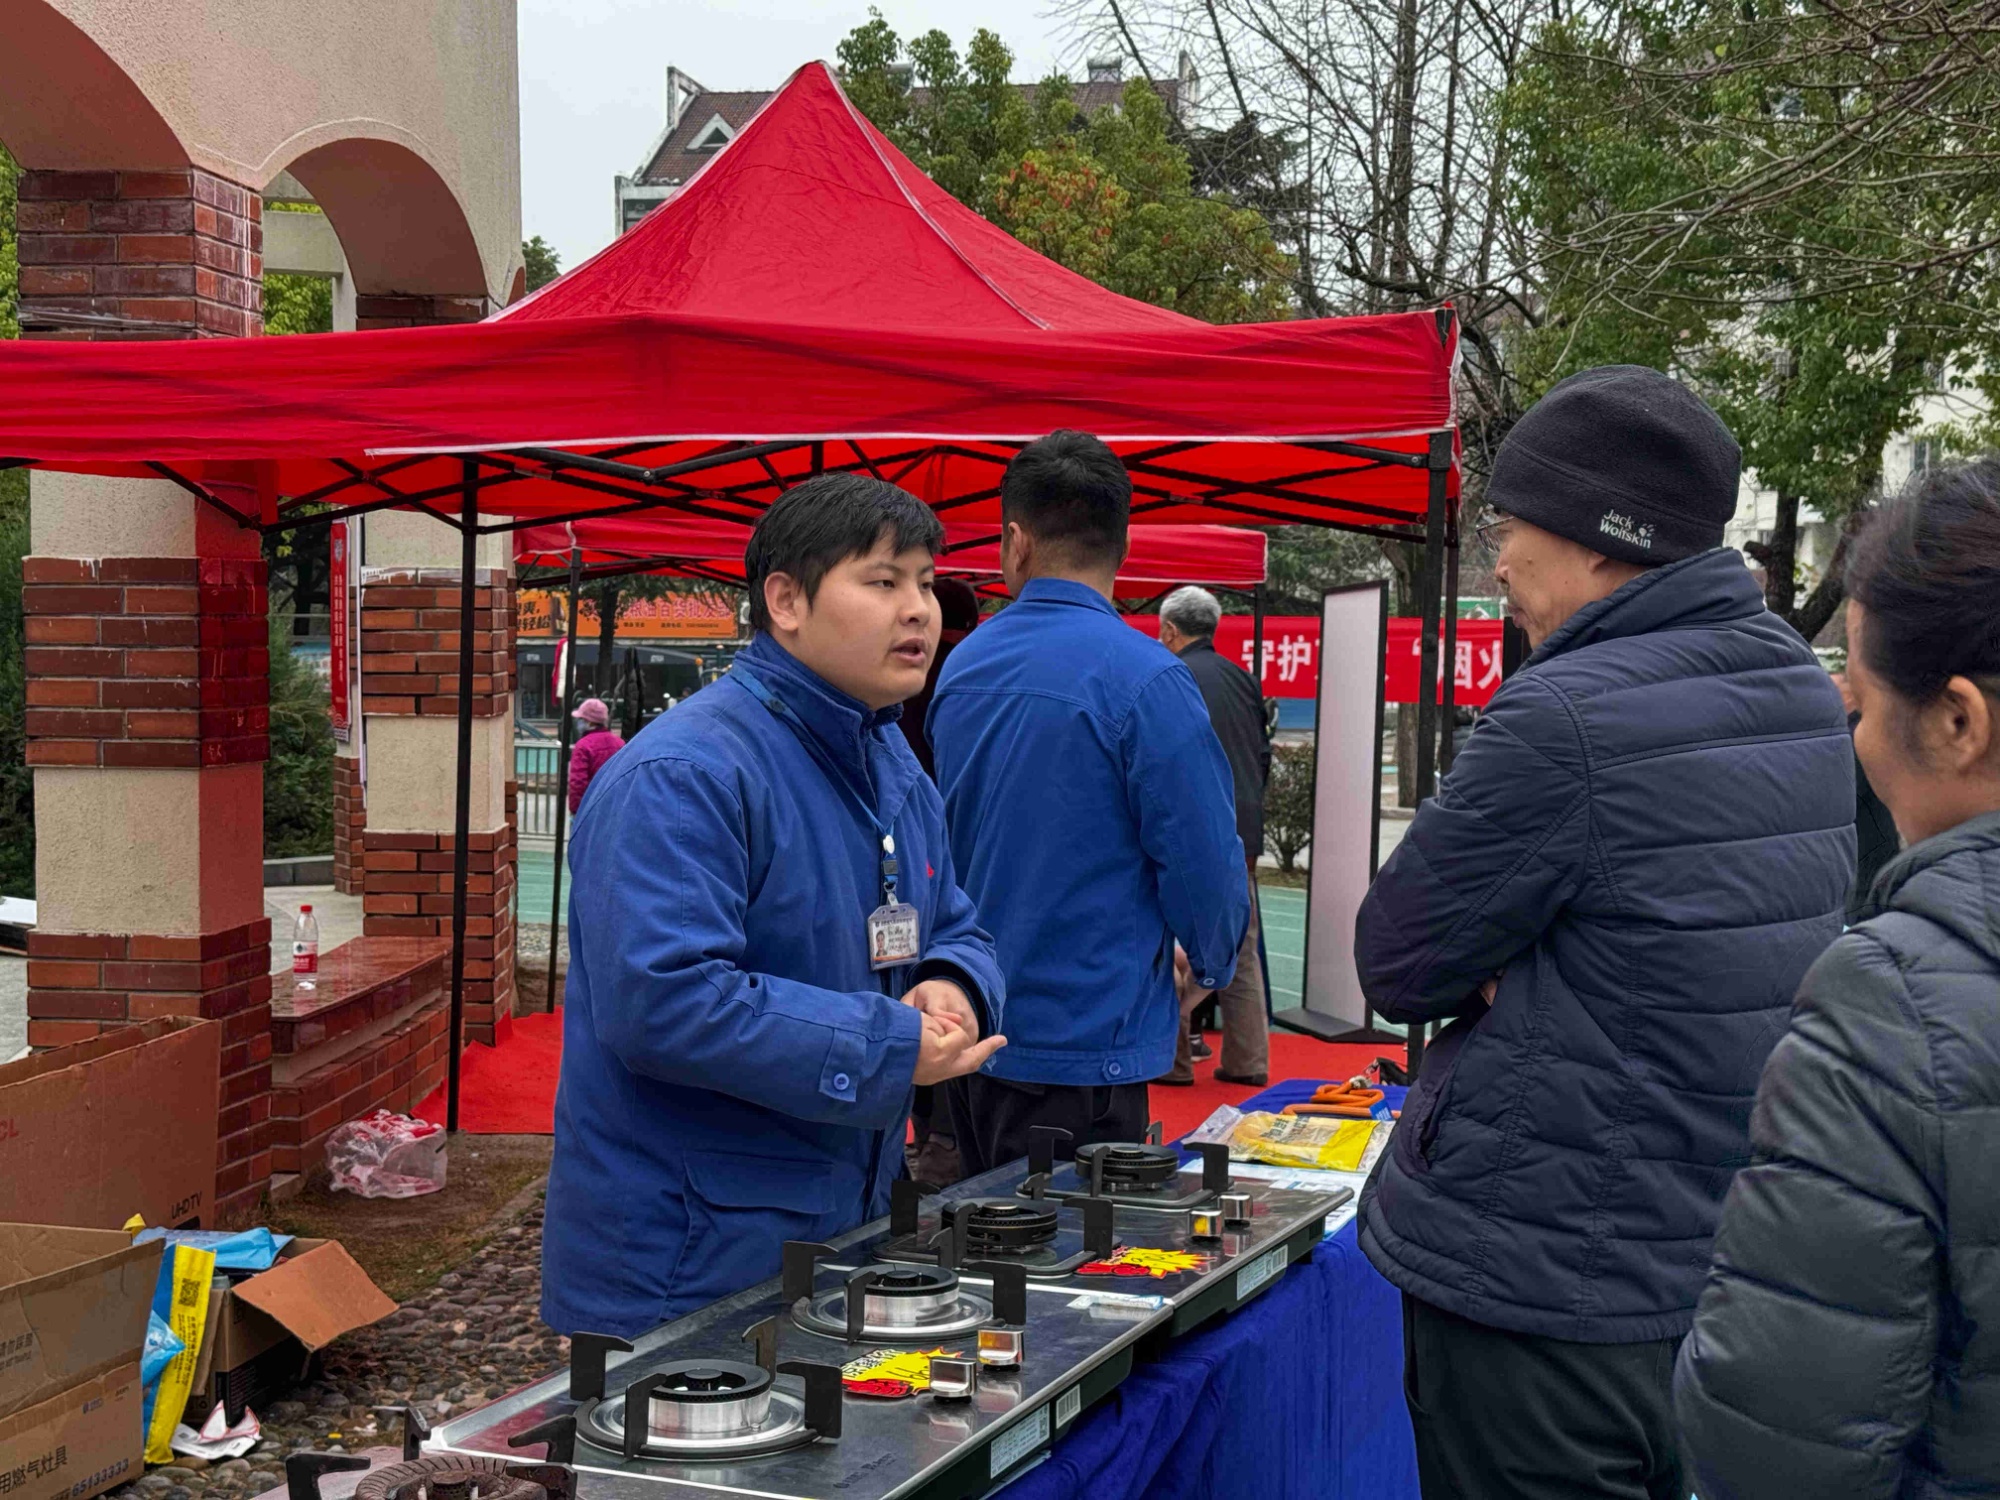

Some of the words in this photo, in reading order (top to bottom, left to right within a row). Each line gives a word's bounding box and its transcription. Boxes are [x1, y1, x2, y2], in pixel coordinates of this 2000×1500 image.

[1599, 519, 1652, 549] Wolfskin
[1603, 509, 1634, 530] Jack
[1241, 634, 1320, 684] 守护
